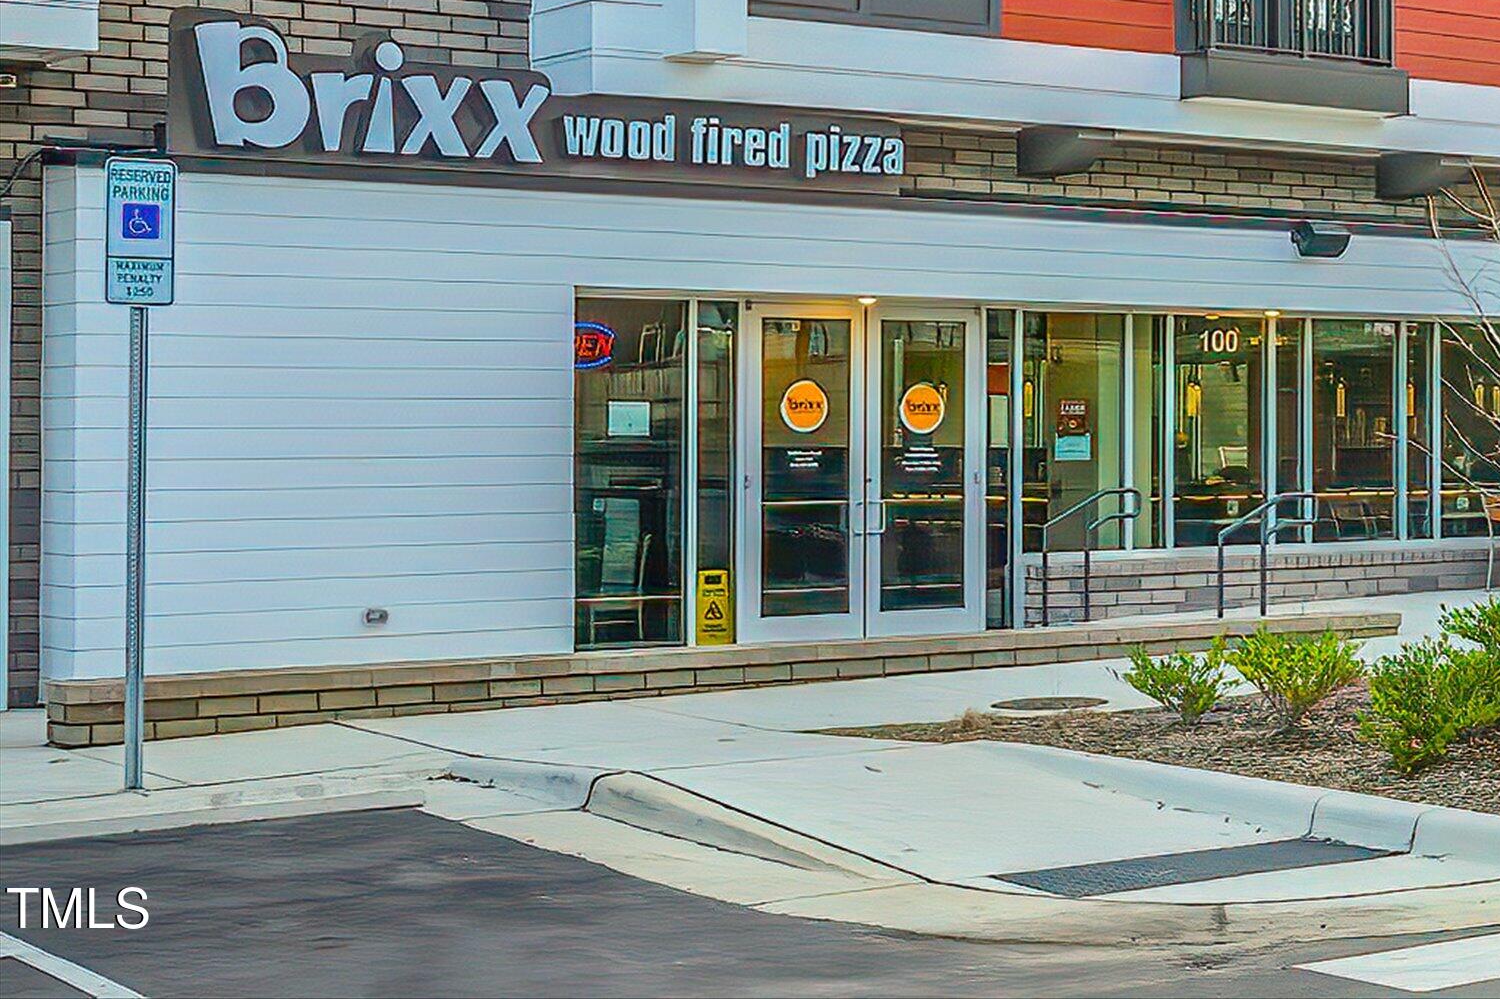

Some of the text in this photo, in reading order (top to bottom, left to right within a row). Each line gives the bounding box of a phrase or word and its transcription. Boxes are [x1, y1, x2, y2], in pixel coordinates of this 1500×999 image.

[563, 115, 676, 161] wood
[691, 118, 790, 168] fired
[806, 126, 904, 178] pizza
[110, 168, 171, 184] RESERVED
[112, 185, 170, 202] PARKING
[116, 260, 164, 271] MAXIMUM
[116, 273, 163, 285] PENALTY
[1199, 329, 1238, 353] 100
